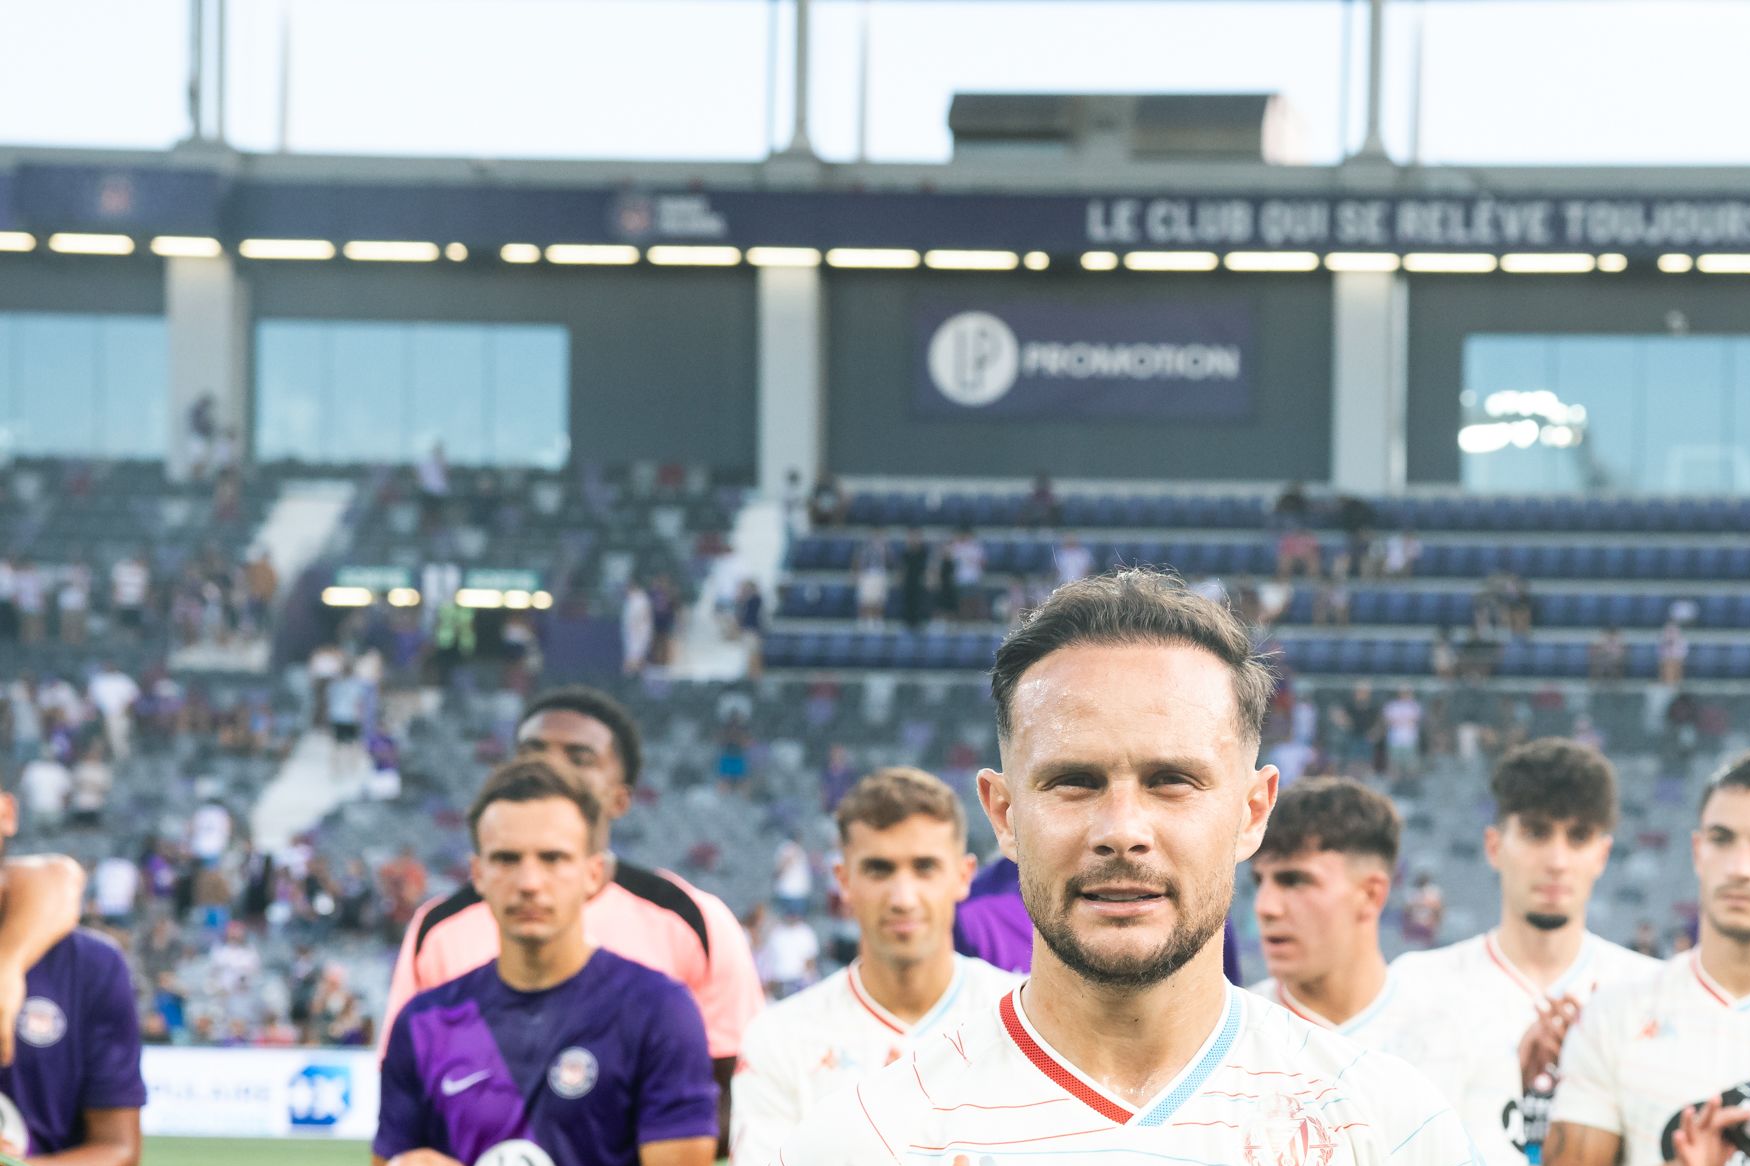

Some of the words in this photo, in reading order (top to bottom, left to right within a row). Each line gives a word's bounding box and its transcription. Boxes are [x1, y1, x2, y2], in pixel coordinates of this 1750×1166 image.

[1087, 199, 1141, 243] LE
[1146, 199, 1251, 243] CLUB
[1259, 199, 1328, 245] QUI
[1337, 200, 1391, 243] SE
[1023, 342, 1241, 381] PROMOTION
